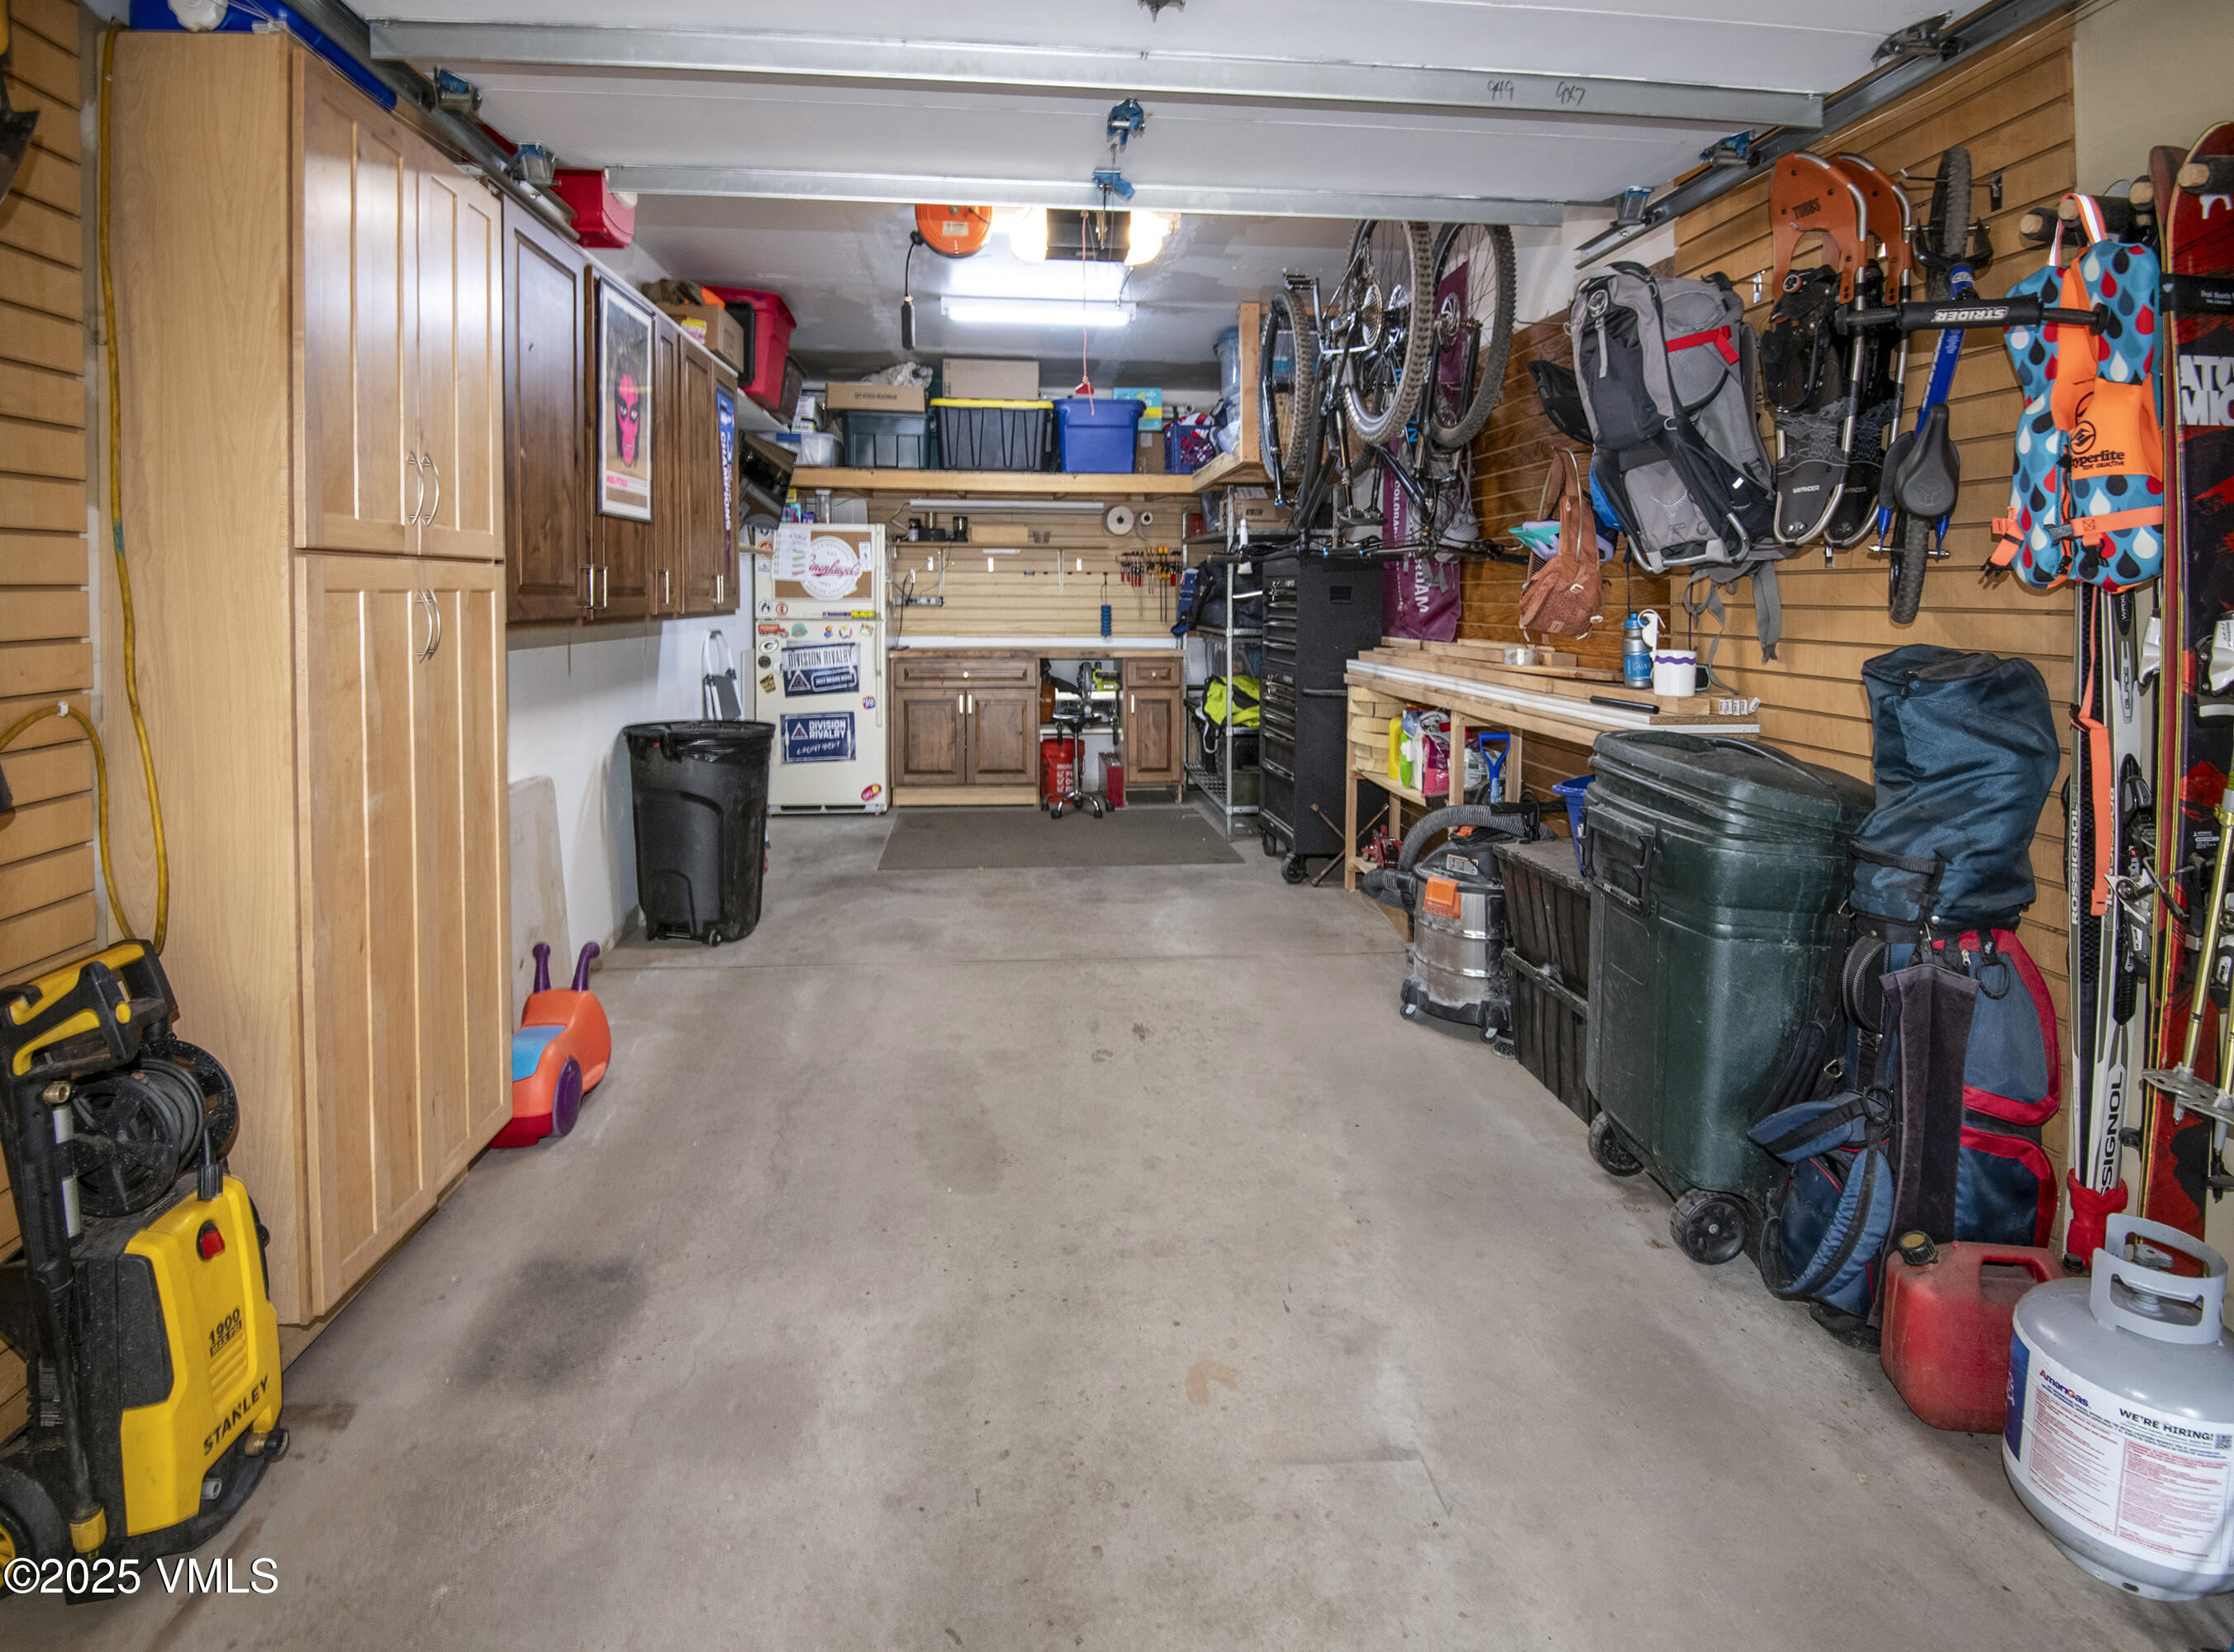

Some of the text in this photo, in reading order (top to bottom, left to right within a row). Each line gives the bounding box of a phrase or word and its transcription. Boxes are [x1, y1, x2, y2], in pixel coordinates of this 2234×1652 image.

[1935, 308, 2007, 321] STRIDER
[2072, 450, 2125, 468] yperlite
[787, 646, 852, 669] DIVISION RIVALRY
[809, 719, 847, 730] DIVISION
[809, 729, 847, 740] RIVALRY
[2101, 1070, 2122, 1196] SIGNOL
[209, 1308, 240, 1345] 1900
[2040, 1370, 2089, 1407] AmeriGas
[203, 1374, 269, 1456] STANLEY
[2119, 1408, 2214, 1441] WE'RE HIRING!
